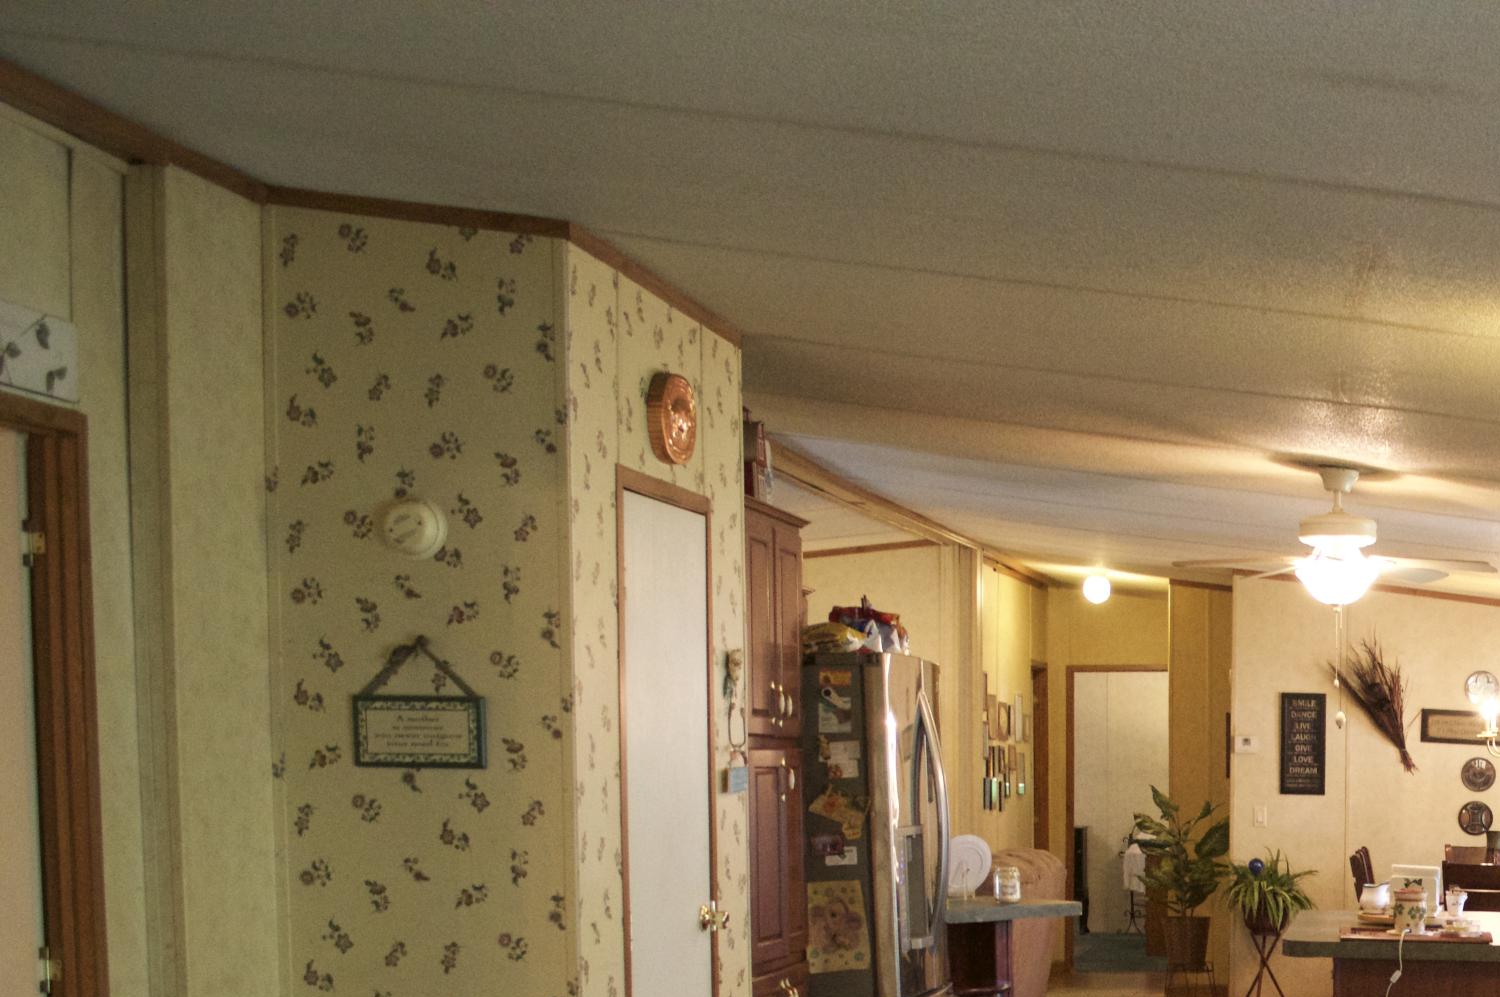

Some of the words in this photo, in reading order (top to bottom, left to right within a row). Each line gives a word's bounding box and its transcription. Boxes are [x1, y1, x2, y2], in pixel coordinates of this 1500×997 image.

[1292, 699, 1316, 707] SMILE
[1291, 711, 1316, 719] DANCE
[1295, 722, 1312, 730] LIVE
[1294, 744, 1312, 752] GIVE
